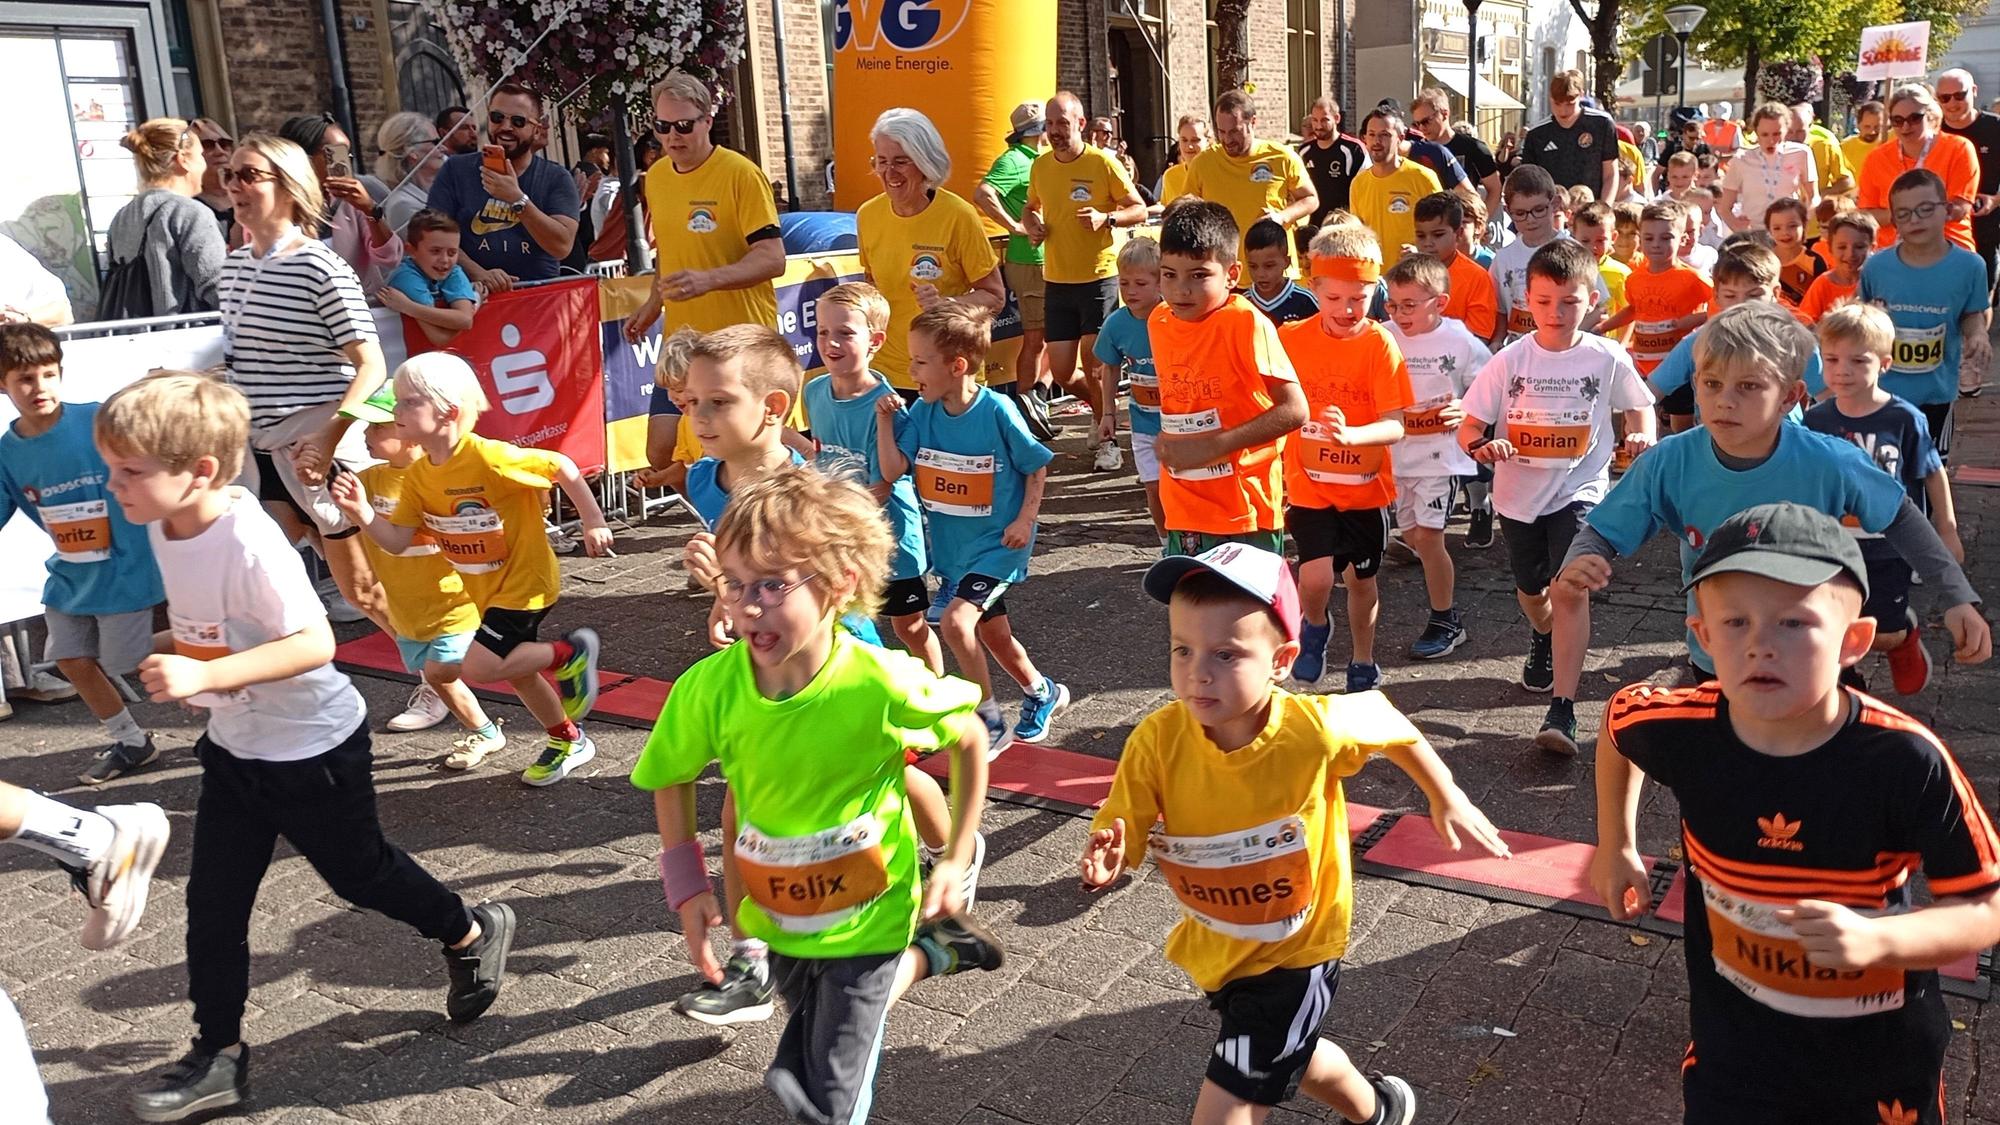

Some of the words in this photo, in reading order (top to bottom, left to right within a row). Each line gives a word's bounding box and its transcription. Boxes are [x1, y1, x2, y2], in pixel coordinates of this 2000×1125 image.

[856, 57, 891, 70] Meine
[895, 56, 953, 74] Energie.
[478, 238, 531, 254] AIR
[1526, 377, 1580, 386] Grundschule
[1533, 384, 1571, 393] Gymnich
[1519, 431, 1578, 449] Darian
[1319, 447, 1361, 465] Felix
[935, 476, 969, 496] Ben
[56, 527, 97, 544] oritz
[441, 538, 487, 555] Henri
[768, 873, 847, 901] Felix
[1179, 876, 1294, 907] Jannes
